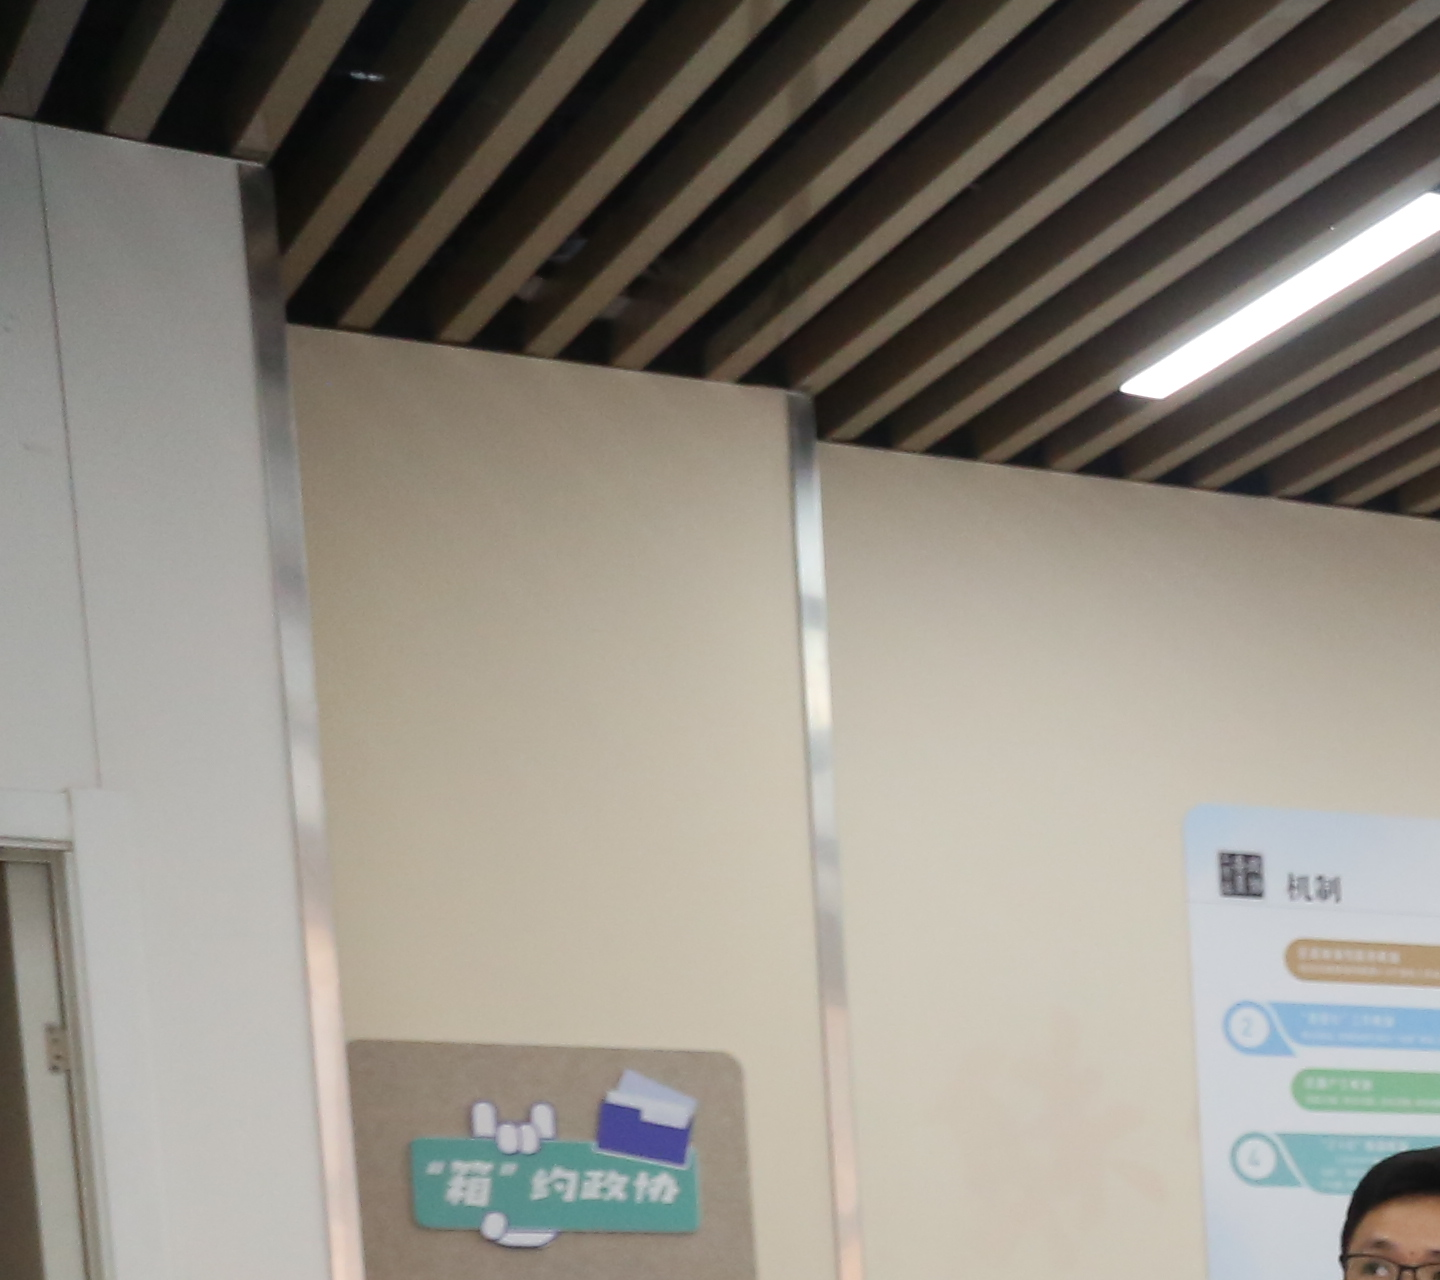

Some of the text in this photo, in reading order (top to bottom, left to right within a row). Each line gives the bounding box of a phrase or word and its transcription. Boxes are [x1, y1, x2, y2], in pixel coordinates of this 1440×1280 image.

[1286, 871, 1343, 904] 机制
[426, 1159, 681, 1207] “箱”约政协
